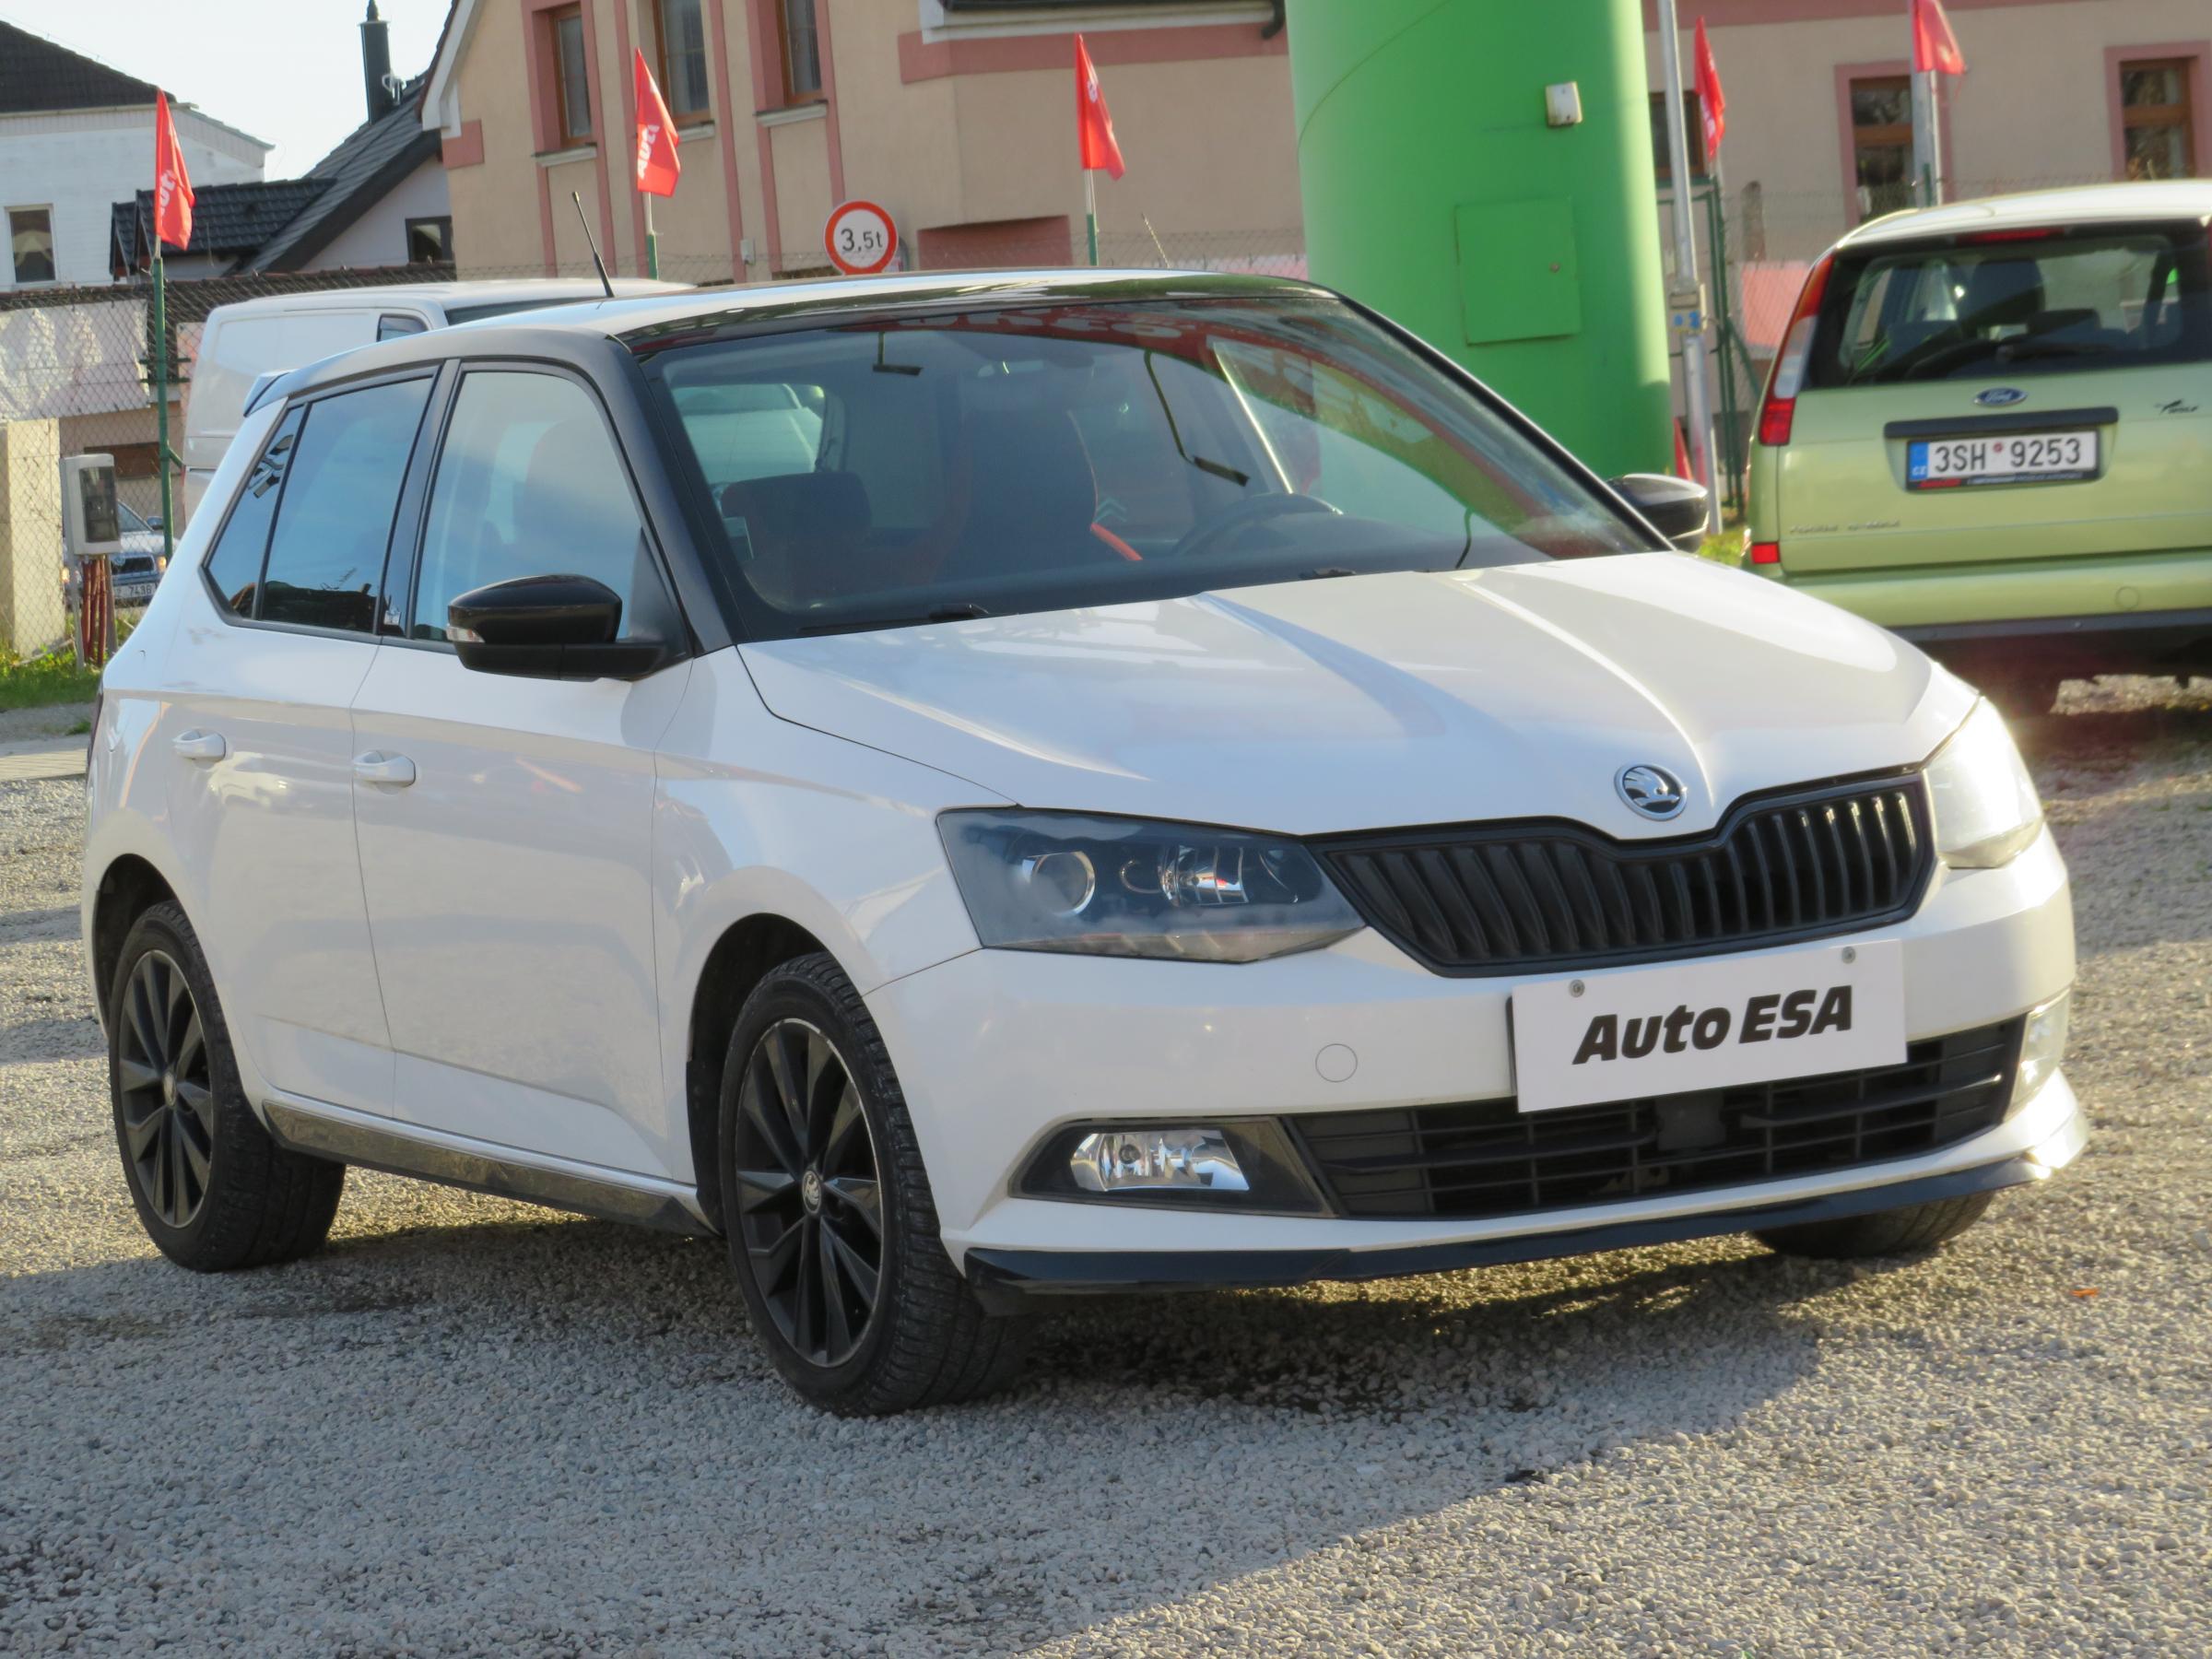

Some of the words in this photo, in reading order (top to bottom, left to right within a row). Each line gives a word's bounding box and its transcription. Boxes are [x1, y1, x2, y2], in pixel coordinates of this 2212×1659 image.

[841, 228, 883, 252] 3,5t
[1935, 443, 1986, 473] 3SH
[2010, 438, 2081, 468] 9253
[1572, 1005, 1731, 1065] Auto
[1738, 985, 1852, 1044] ESA
